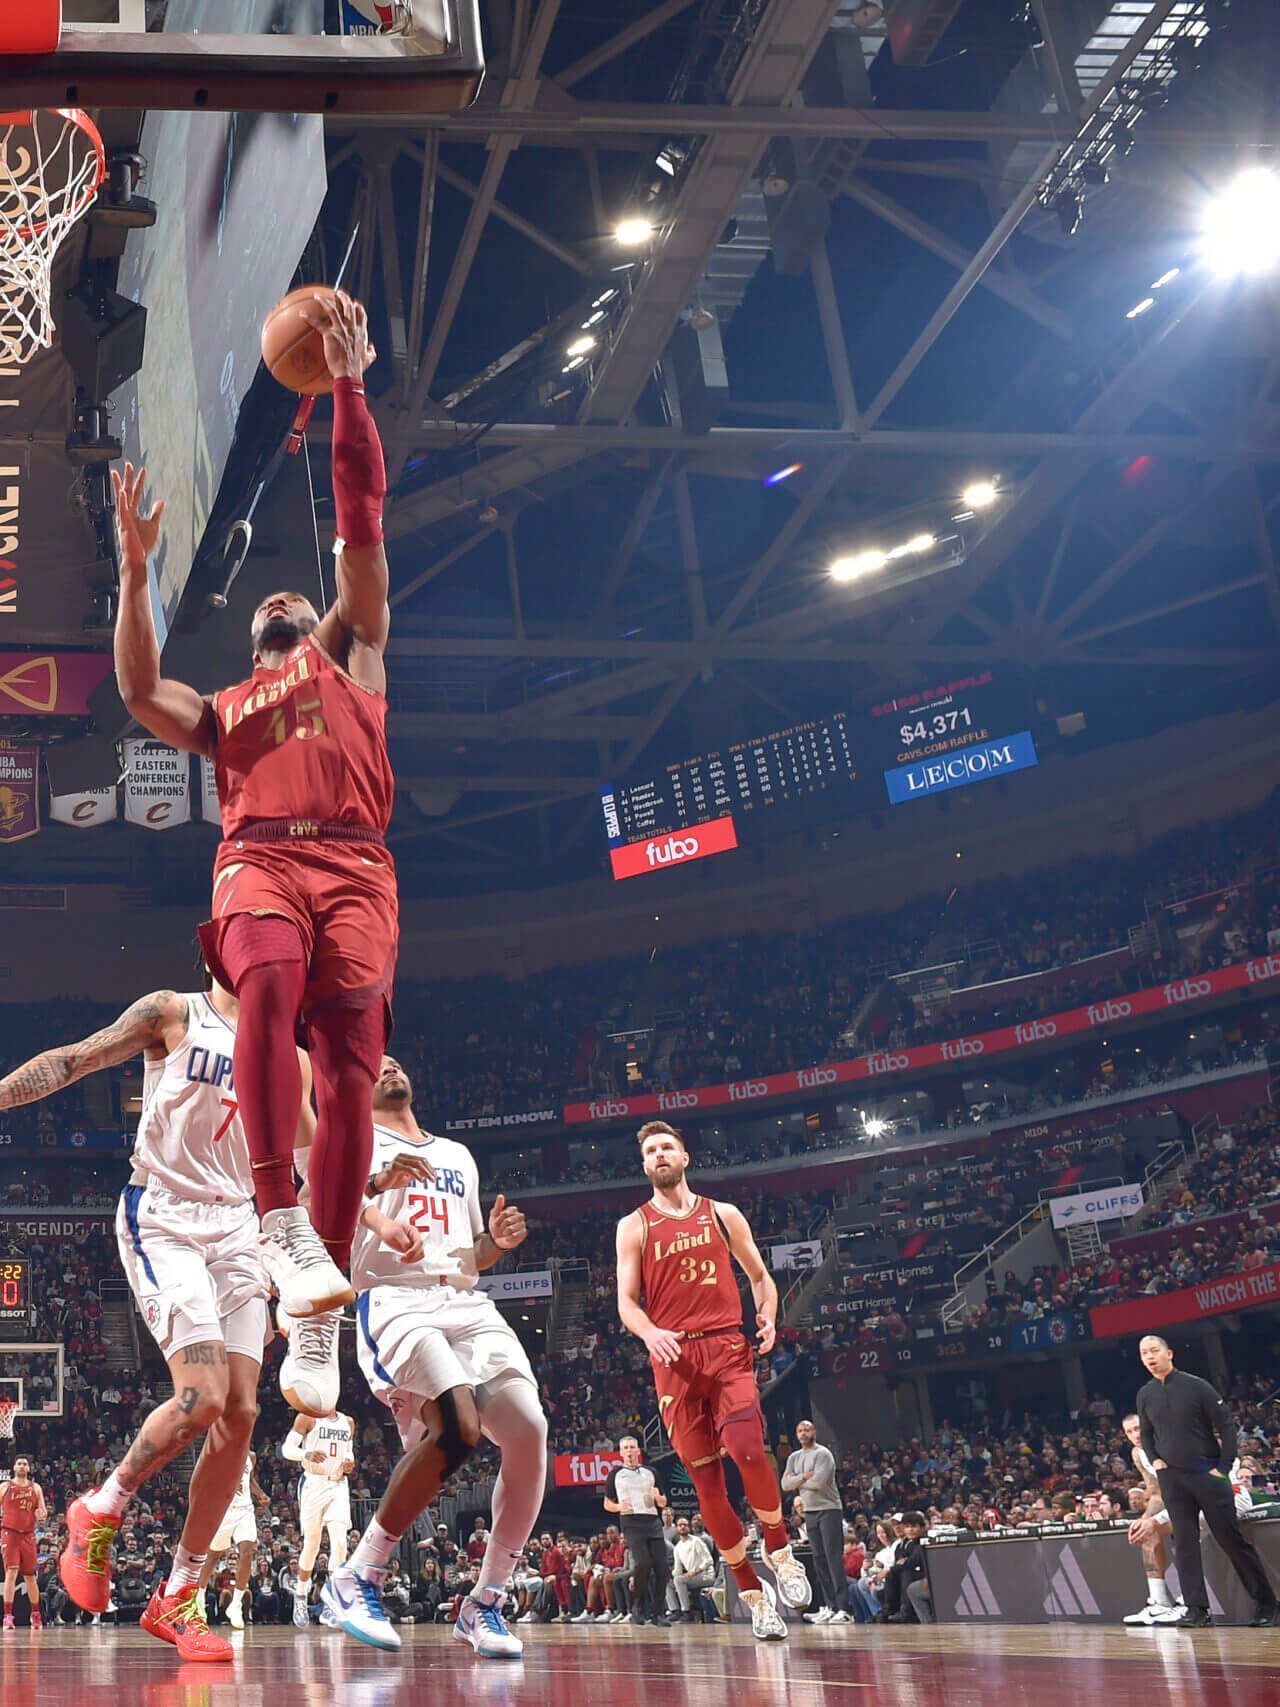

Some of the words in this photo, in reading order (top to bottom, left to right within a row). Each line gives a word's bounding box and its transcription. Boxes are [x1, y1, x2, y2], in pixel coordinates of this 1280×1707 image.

[224, 656, 312, 736] Land
[256, 681, 280, 693] The
[263, 699, 324, 745] 45
[899, 707, 972, 745] $4,371
[135, 761, 178, 771] EASTERN
[127, 773, 188, 785] CONFERENCE
[630, 781, 655, 795] Leonard
[129, 786, 185, 797] CHAMPIONS
[290, 824, 318, 836] CAVS
[645, 835, 698, 867] fubo
[588, 1099, 628, 1120] fubo
[657, 1092, 698, 1111] fubo
[728, 1080, 768, 1101] fubo
[796, 1068, 837, 1089] fubo
[866, 1053, 910, 1076] fubo
[940, 1038, 984, 1061] fubo
[1014, 1020, 1057, 1044] fubo
[1087, 999, 1132, 1024] fubo
[1163, 979, 1211, 1005] fubo
[187, 1046, 234, 1091] CLIP
[214, 1098, 238, 1142] 7
[445, 1119, 476, 1130] LET
[478, 1115, 502, 1128] EM
[503, 1110, 558, 1125] KNOW.
[1024, 1126, 1049, 1139] M104
[1085, 1194, 1140, 1213] CLIFFS
[408, 1194, 449, 1235] 24
[654, 1226, 713, 1261] Land
[679, 1256, 718, 1286] 32
[896, 1264, 935, 1279] Homes
[502, 1279, 549, 1291] CLIFFS
[1195, 1281, 1247, 1311] WATCH
[1247, 1270, 1278, 1297] THE
[865, 1297, 897, 1309] Homes
[812, 1366, 820, 1377] 2
[860, 1351, 880, 1368] 22
[897, 1350, 911, 1361] 1Q
[937, 1342, 966, 1356] 3:23
[1021, 1326, 1039, 1346] 17
[1077, 1323, 1085, 1336] 3
[318, 1426, 349, 1442] CLIPPERS
[329, 1442, 337, 1457] 0
